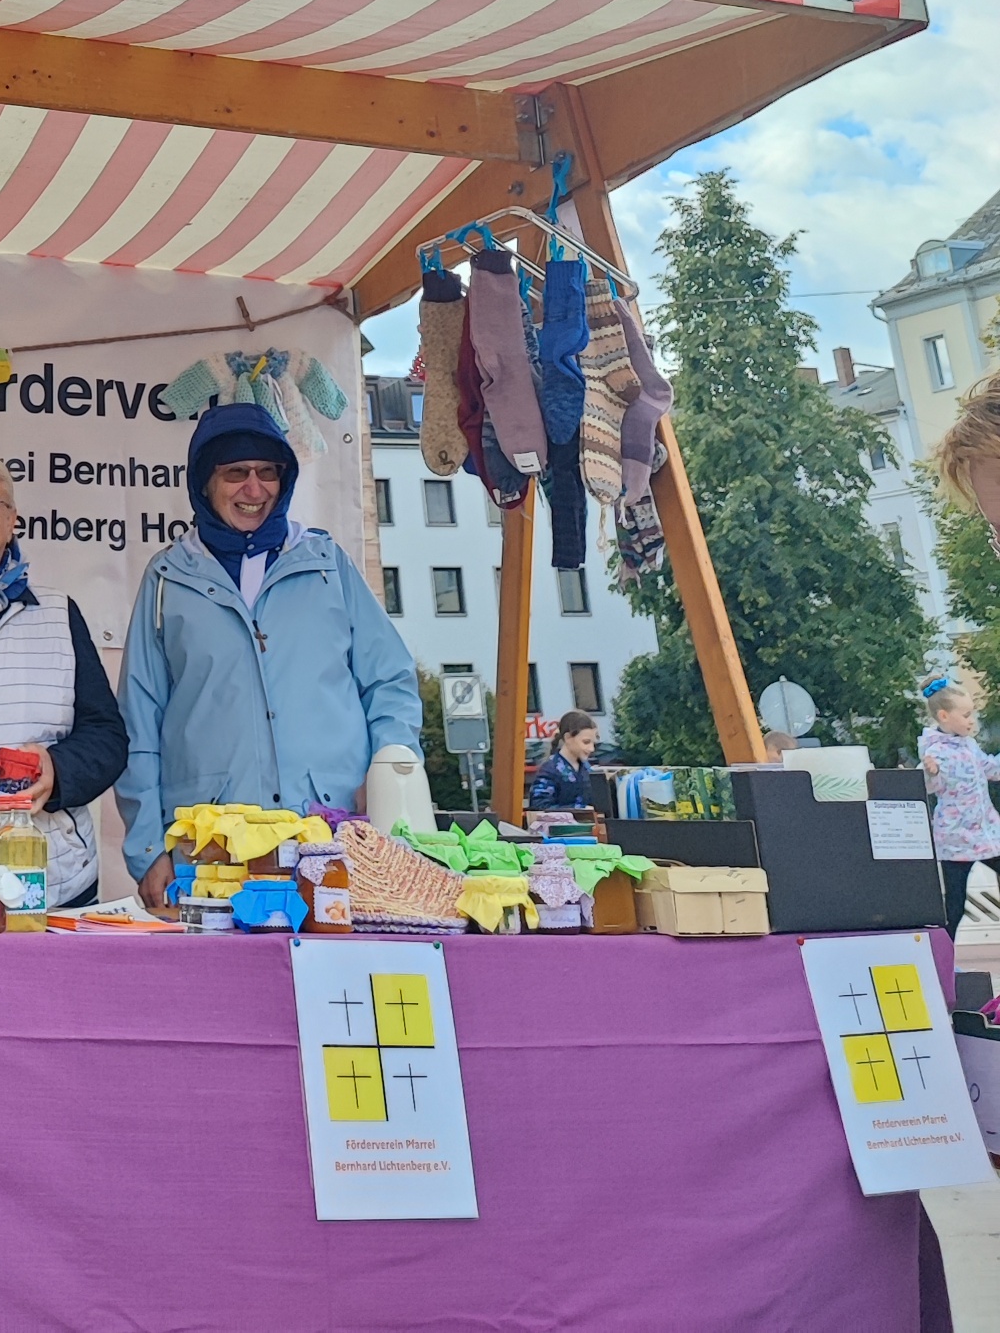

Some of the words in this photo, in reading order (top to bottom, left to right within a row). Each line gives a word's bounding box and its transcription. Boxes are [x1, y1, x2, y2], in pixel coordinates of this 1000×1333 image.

[49, 452, 186, 487] Bernhar
[14, 509, 126, 551] enberg
[872, 1117, 922, 1129] Förderverein
[922, 1114, 948, 1125] Pfarrei
[346, 1139, 404, 1150] Förderverein
[405, 1138, 436, 1150] Pfarrei
[866, 1138, 902, 1149] Bernhard
[903, 1135, 949, 1146] Lichtenberg
[949, 1132, 965, 1143] e.V.
[335, 1160, 377, 1171] Bernhard
[378, 1160, 432, 1173] Lichtenberg
[433, 1160, 451, 1171] e.V.
